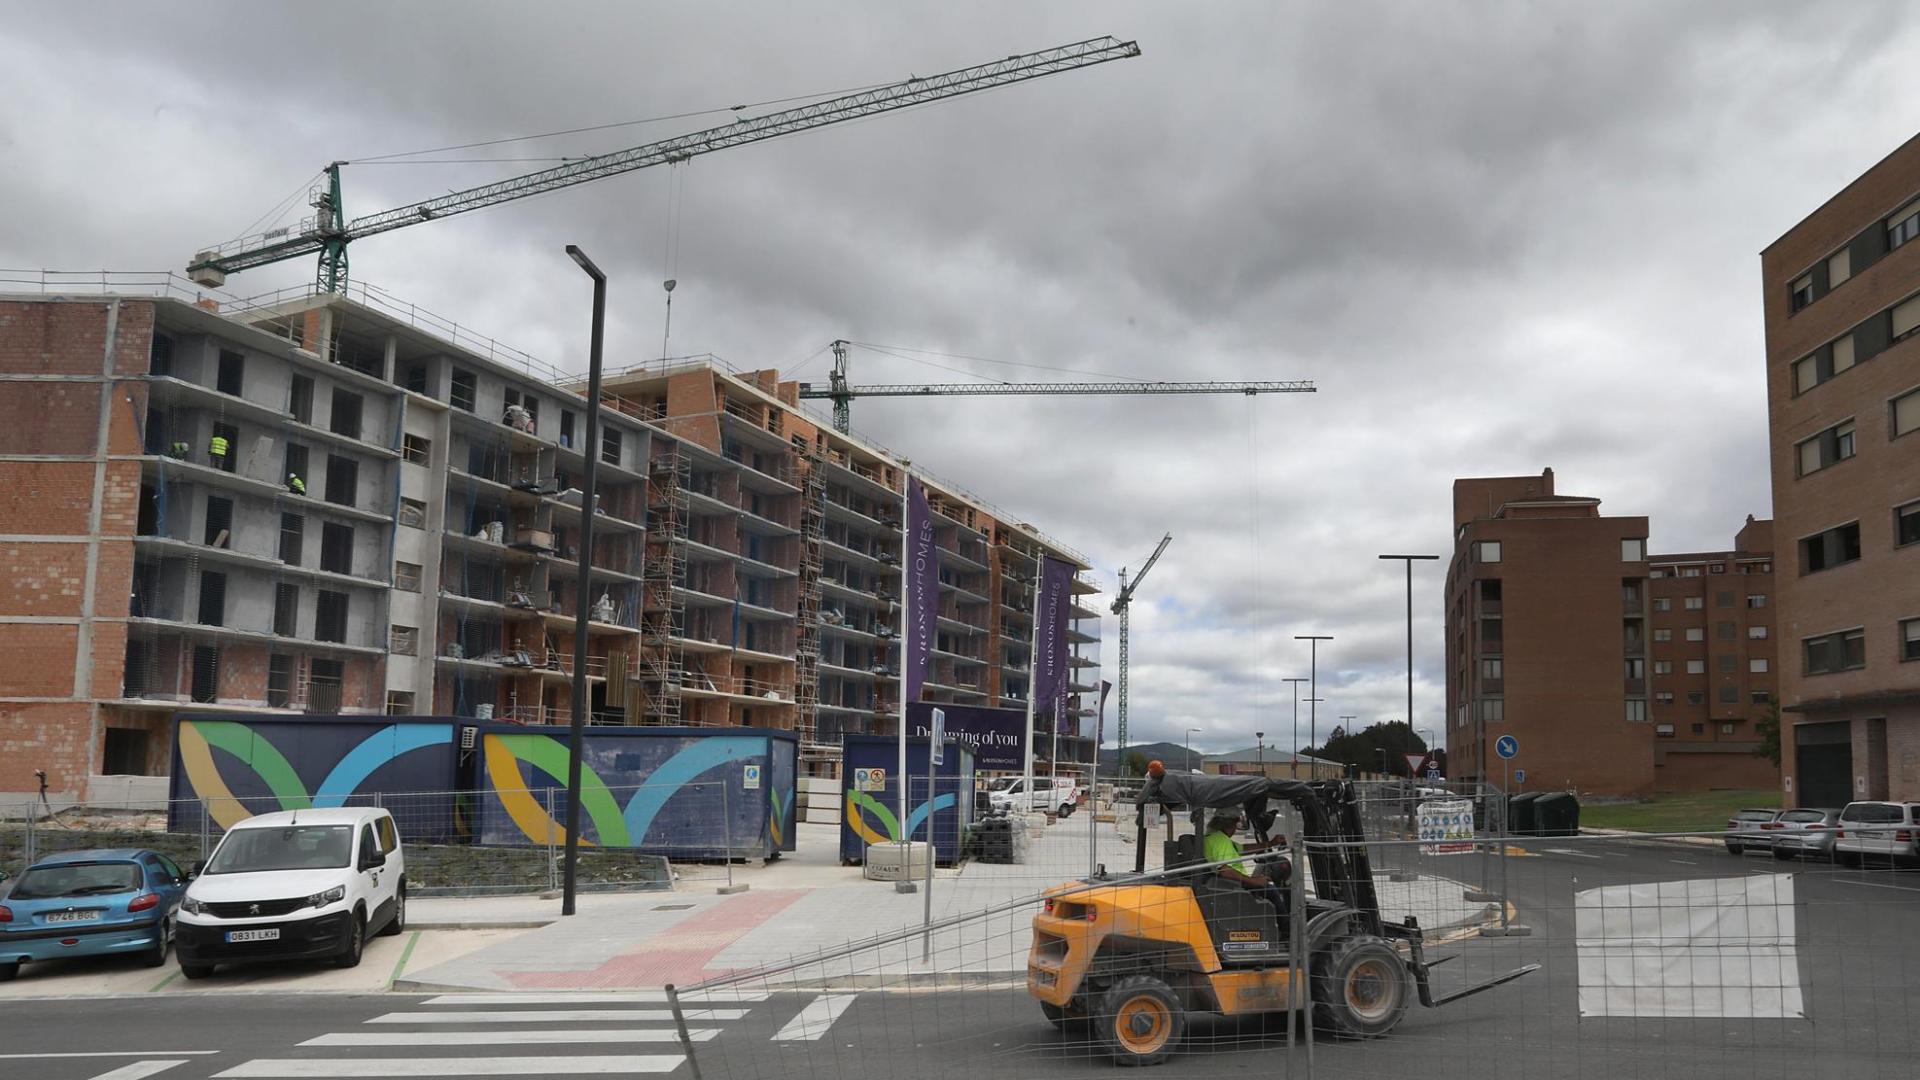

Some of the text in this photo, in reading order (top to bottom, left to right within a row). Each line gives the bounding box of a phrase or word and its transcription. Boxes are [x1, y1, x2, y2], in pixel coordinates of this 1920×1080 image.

[1047, 581, 1061, 676] KRONOSHOMES
[981, 730, 995, 745] of
[996, 734, 1019, 749] you
[232, 930, 277, 941] 0831 LKH
